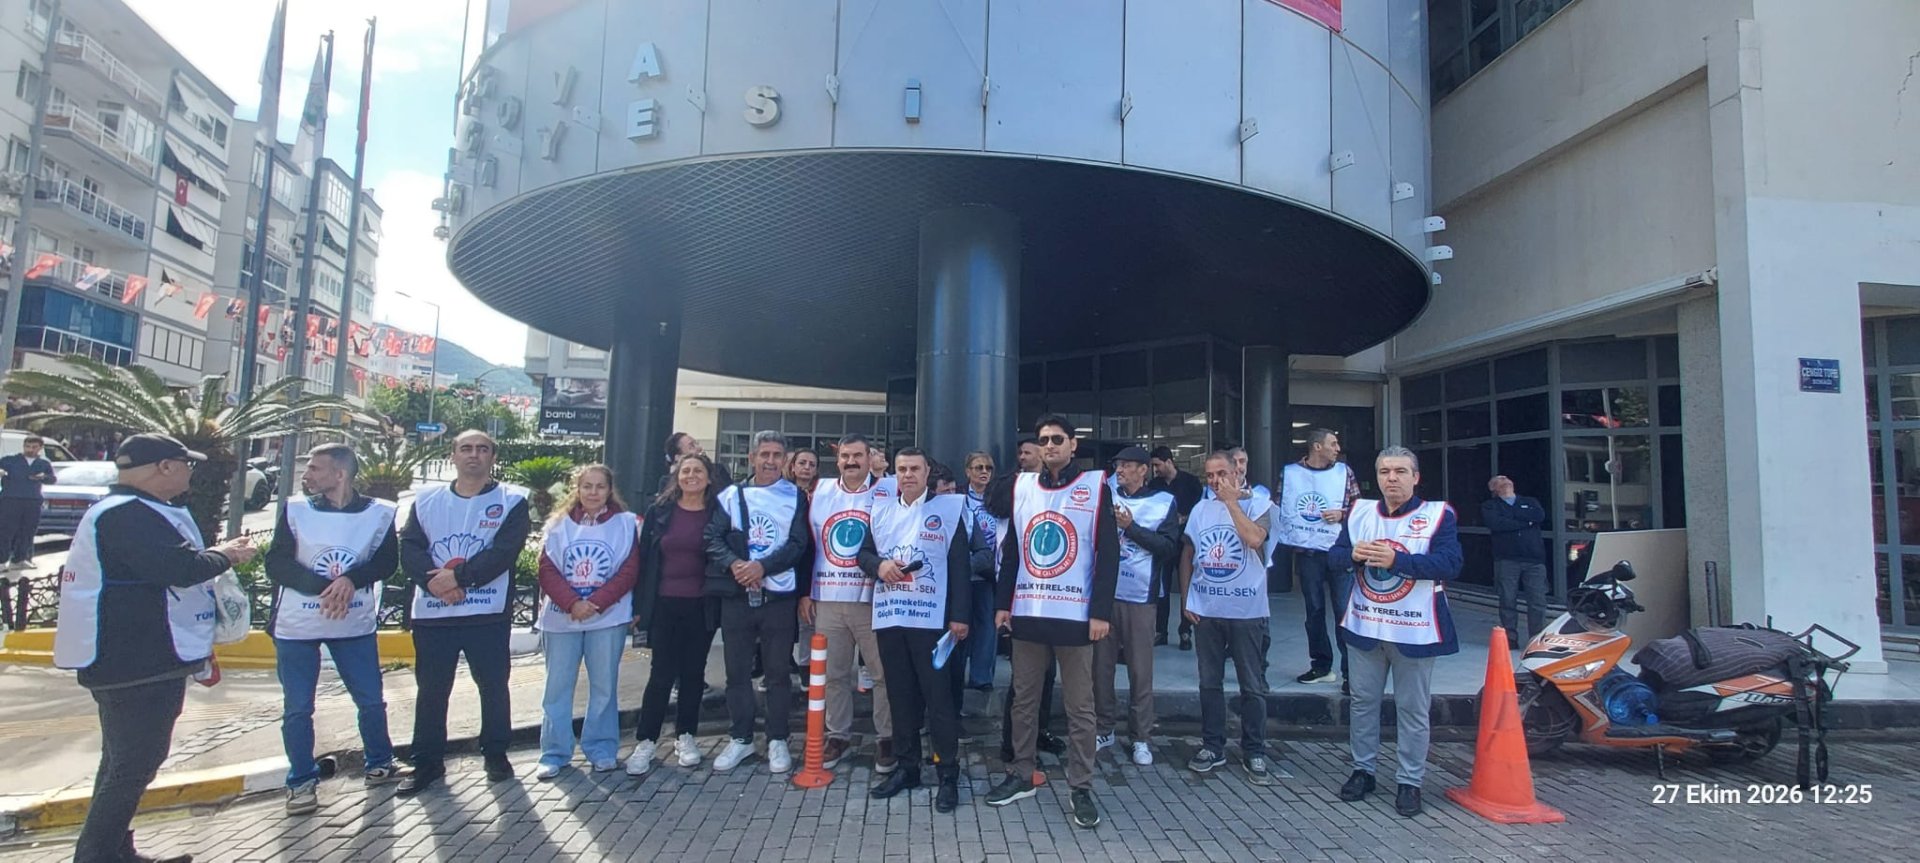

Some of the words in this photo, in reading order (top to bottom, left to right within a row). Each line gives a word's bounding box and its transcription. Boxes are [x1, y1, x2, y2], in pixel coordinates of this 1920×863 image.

[919, 585, 936, 594] SEN
[1208, 586, 1256, 597] BEL-SEN
[1372, 606, 1423, 618] YEREL-SEN
